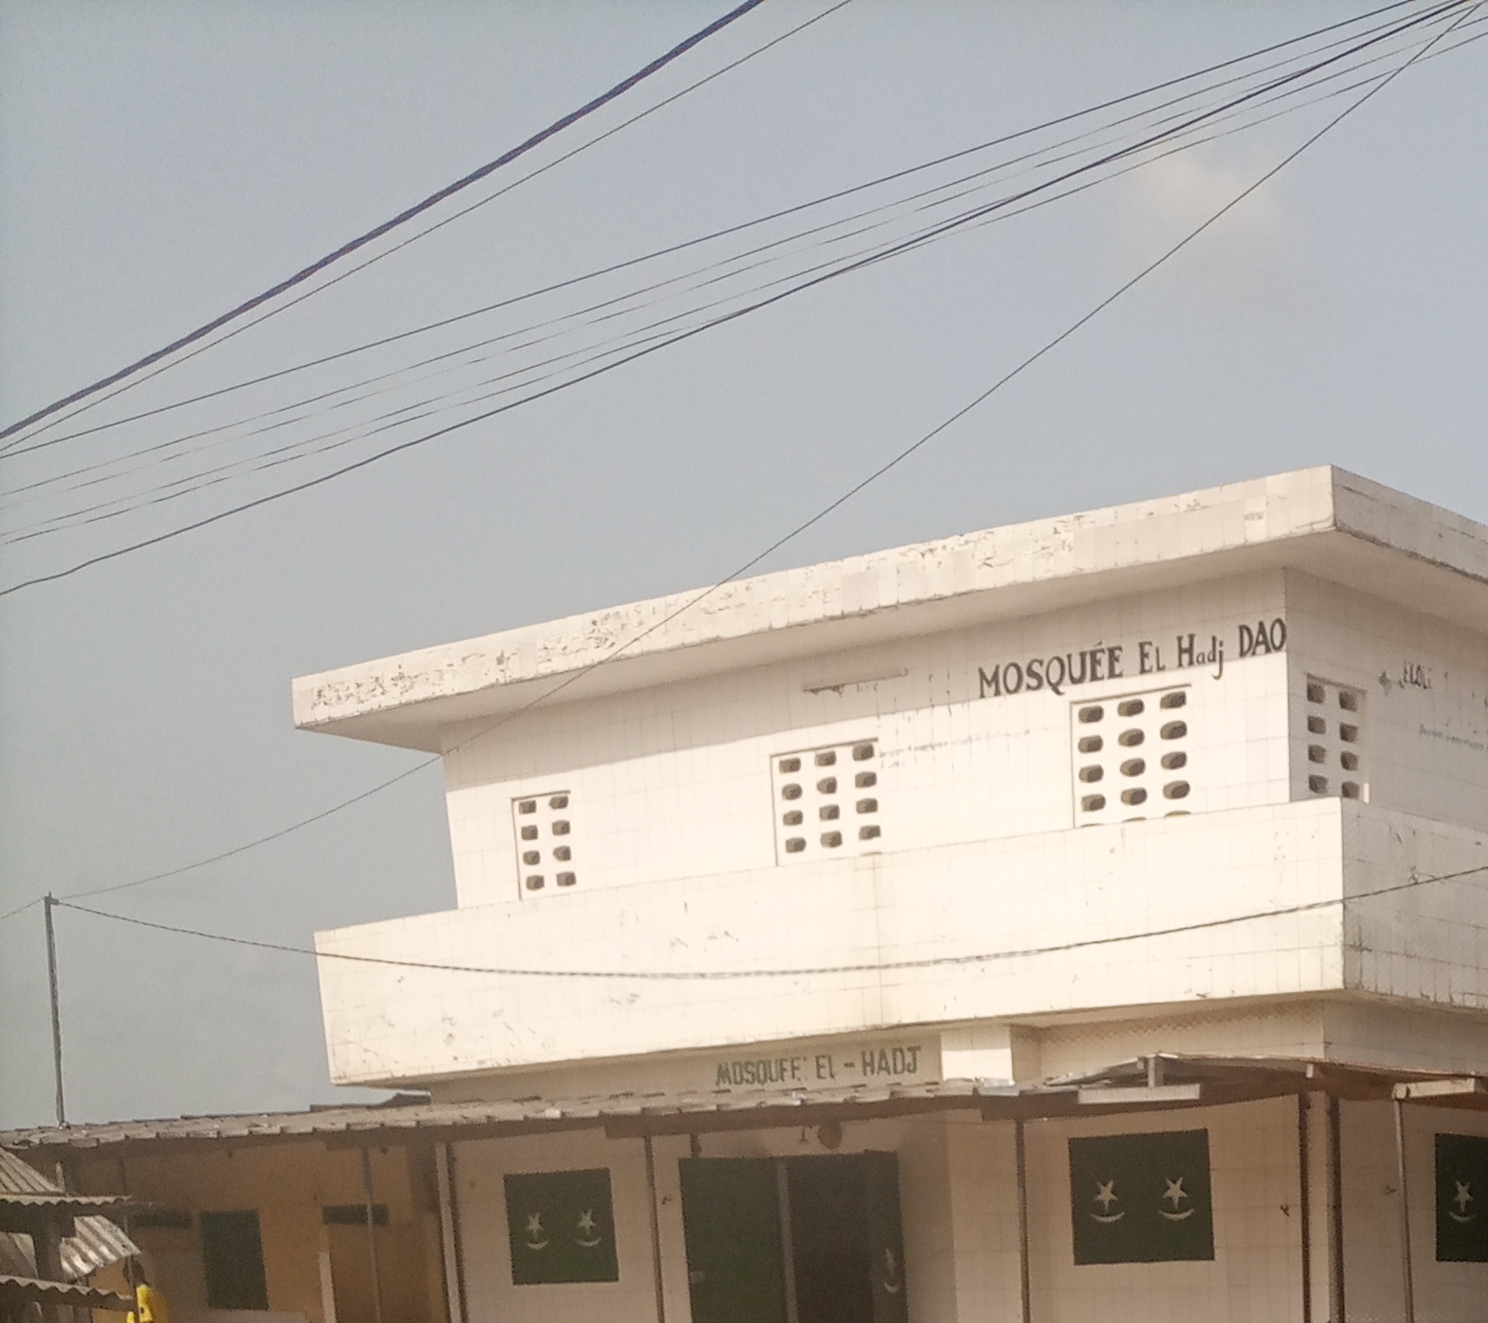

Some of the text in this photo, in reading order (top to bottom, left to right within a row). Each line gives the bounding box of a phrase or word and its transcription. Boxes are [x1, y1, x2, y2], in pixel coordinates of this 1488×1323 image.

[978, 640, 1123, 698] MOSQUÉE
[1176, 633, 1223, 680] Hadj
[1237, 618, 1287, 658] DAO
[861, 1046, 922, 1077] HADJ
